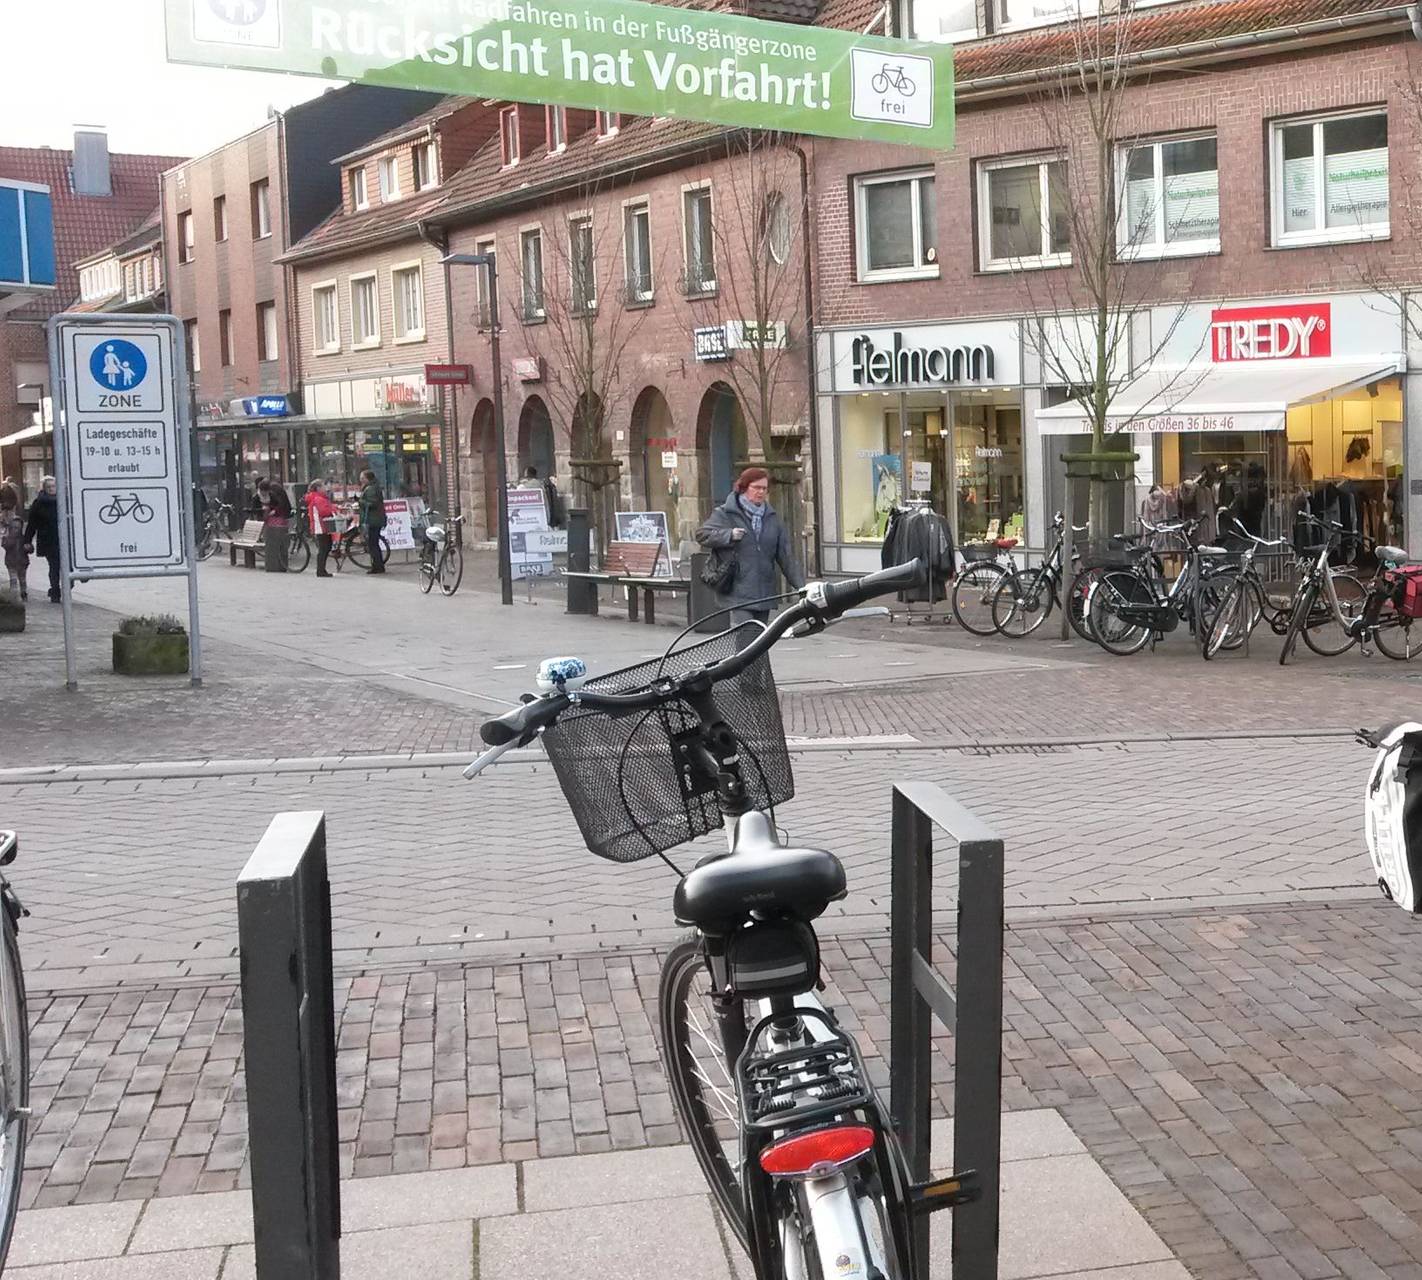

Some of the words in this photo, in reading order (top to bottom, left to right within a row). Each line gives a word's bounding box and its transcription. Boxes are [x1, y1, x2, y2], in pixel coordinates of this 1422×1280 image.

[584, 13, 605, 34] in
[613, 15, 648, 39] der
[656, 20, 817, 62] Fußgängerzone
[310, 6, 550, 77] Rücksicht
[561, 38, 636, 88] hat
[643, 50, 832, 111] Vorfahrt!
[880, 99, 906, 115] frei
[98, 394, 142, 407] ZONE
[1081, 419, 1112, 432] Tres
[1150, 417, 1184, 432] Größen
[1187, 417, 1200, 430] 36
[1203, 416, 1217, 429] bis
[1220, 416, 1234, 429] 46
[86, 428, 158, 441] Ladegeschäfte
[127, 446, 151, 456] 13-15
[155, 446, 161, 455] h
[108, 463, 140, 473] erlaubt
[120, 543, 138, 553] frei
